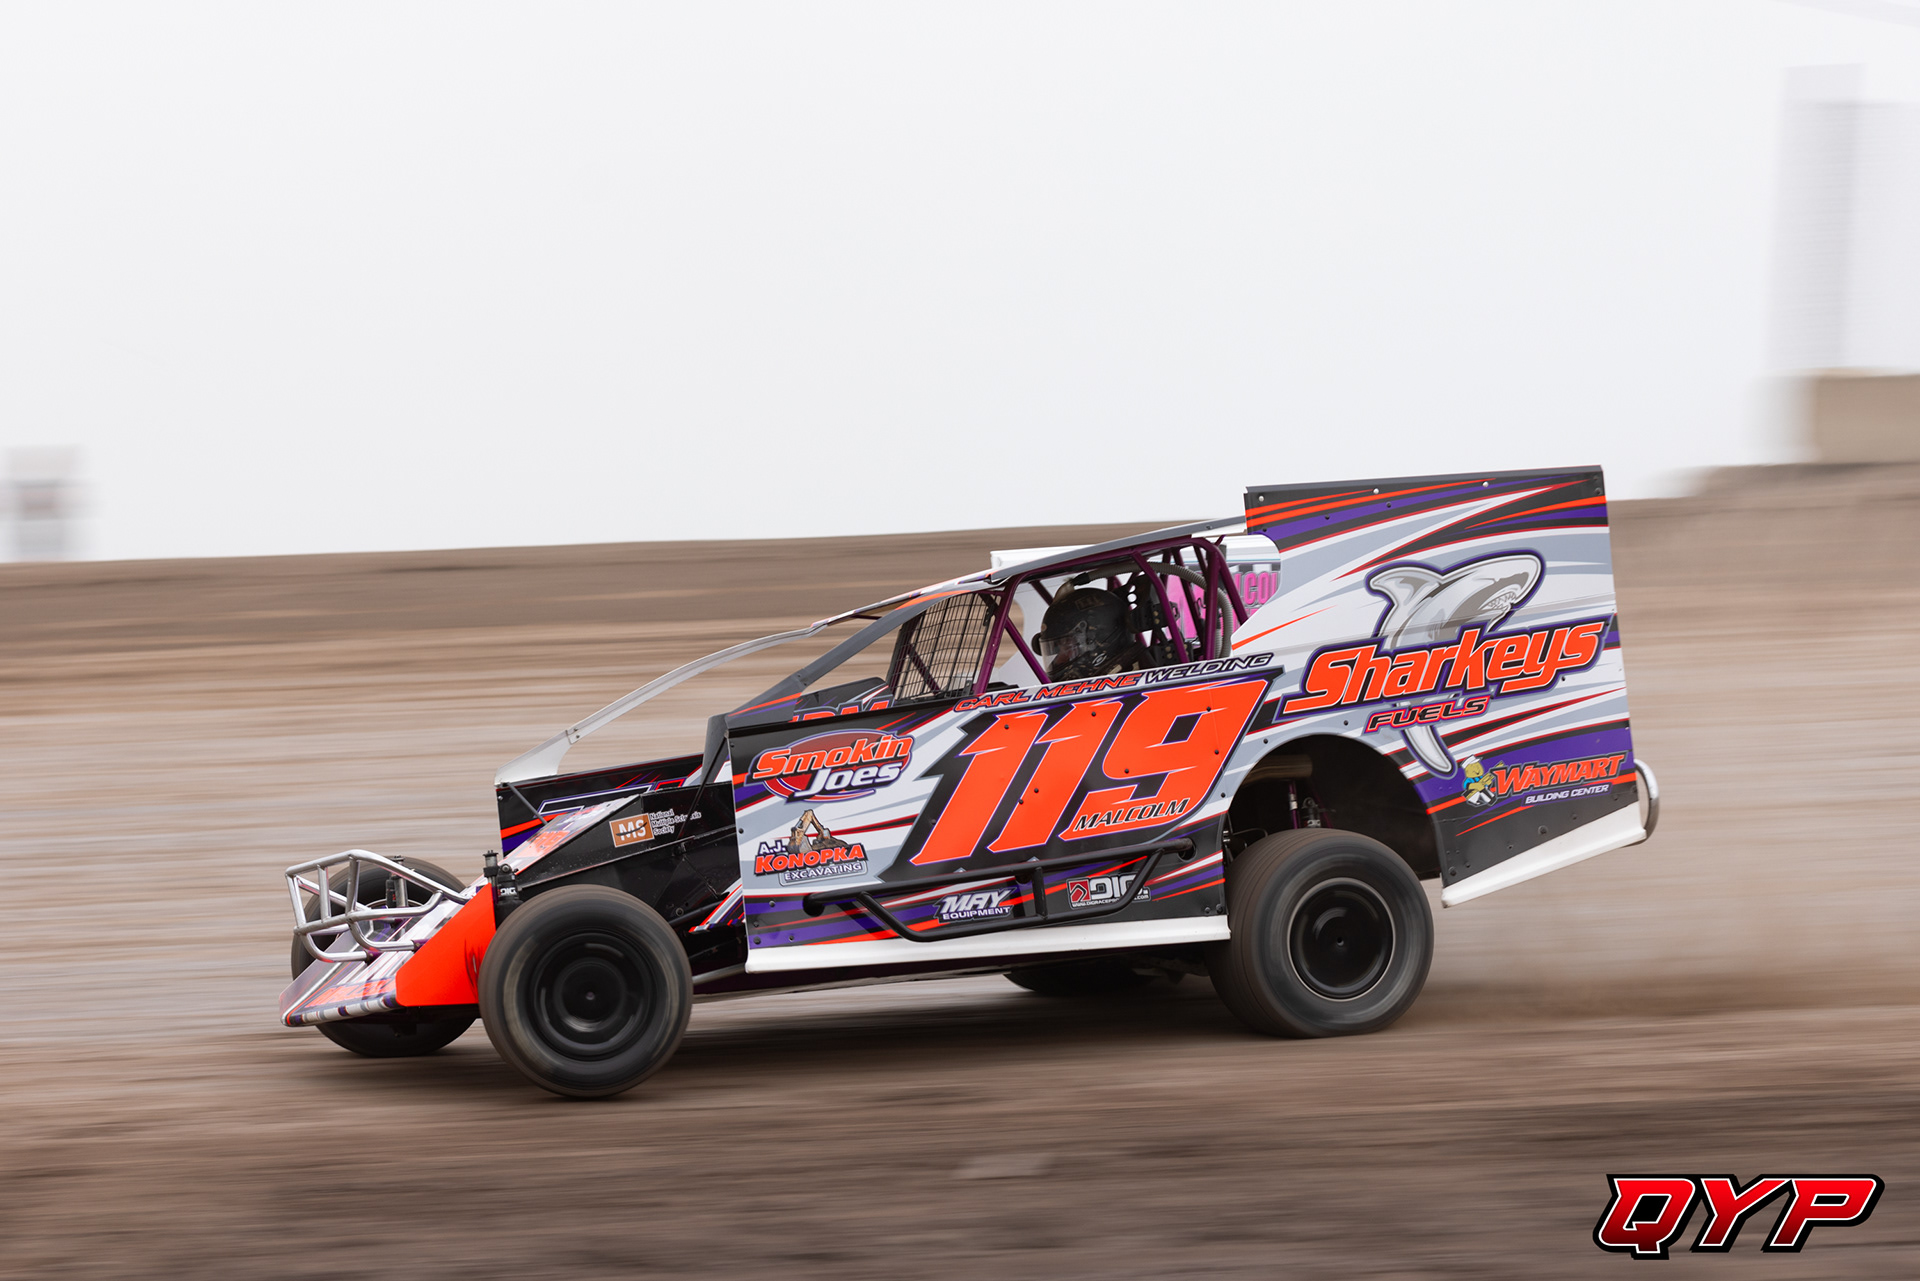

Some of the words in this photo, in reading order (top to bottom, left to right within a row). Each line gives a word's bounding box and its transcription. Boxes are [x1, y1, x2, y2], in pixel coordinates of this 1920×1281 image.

[954, 690, 1029, 712] CARL
[1036, 673, 1142, 700] MEHNE
[1146, 652, 1274, 684] WELDING
[1281, 621, 1605, 713] Sharkeys
[1367, 697, 1489, 732] FUELS
[753, 732, 913, 779] Smokin
[909, 680, 1268, 866] 119
[793, 761, 903, 798] Joes
[1493, 755, 1625, 795] WAYMART
[1525, 790, 1570, 804] BUILDING
[1570, 784, 1609, 798] CENTER
[616, 819, 647, 841] MS
[1072, 797, 1190, 832] MALCOLM
[754, 844, 865, 874] KONOPKA
[759, 841, 786, 855] A.J.
[784, 862, 862, 881] EXCAVATING
[940, 889, 1012, 914] MAY
[942, 906, 1011, 920] EQUIPMENT
